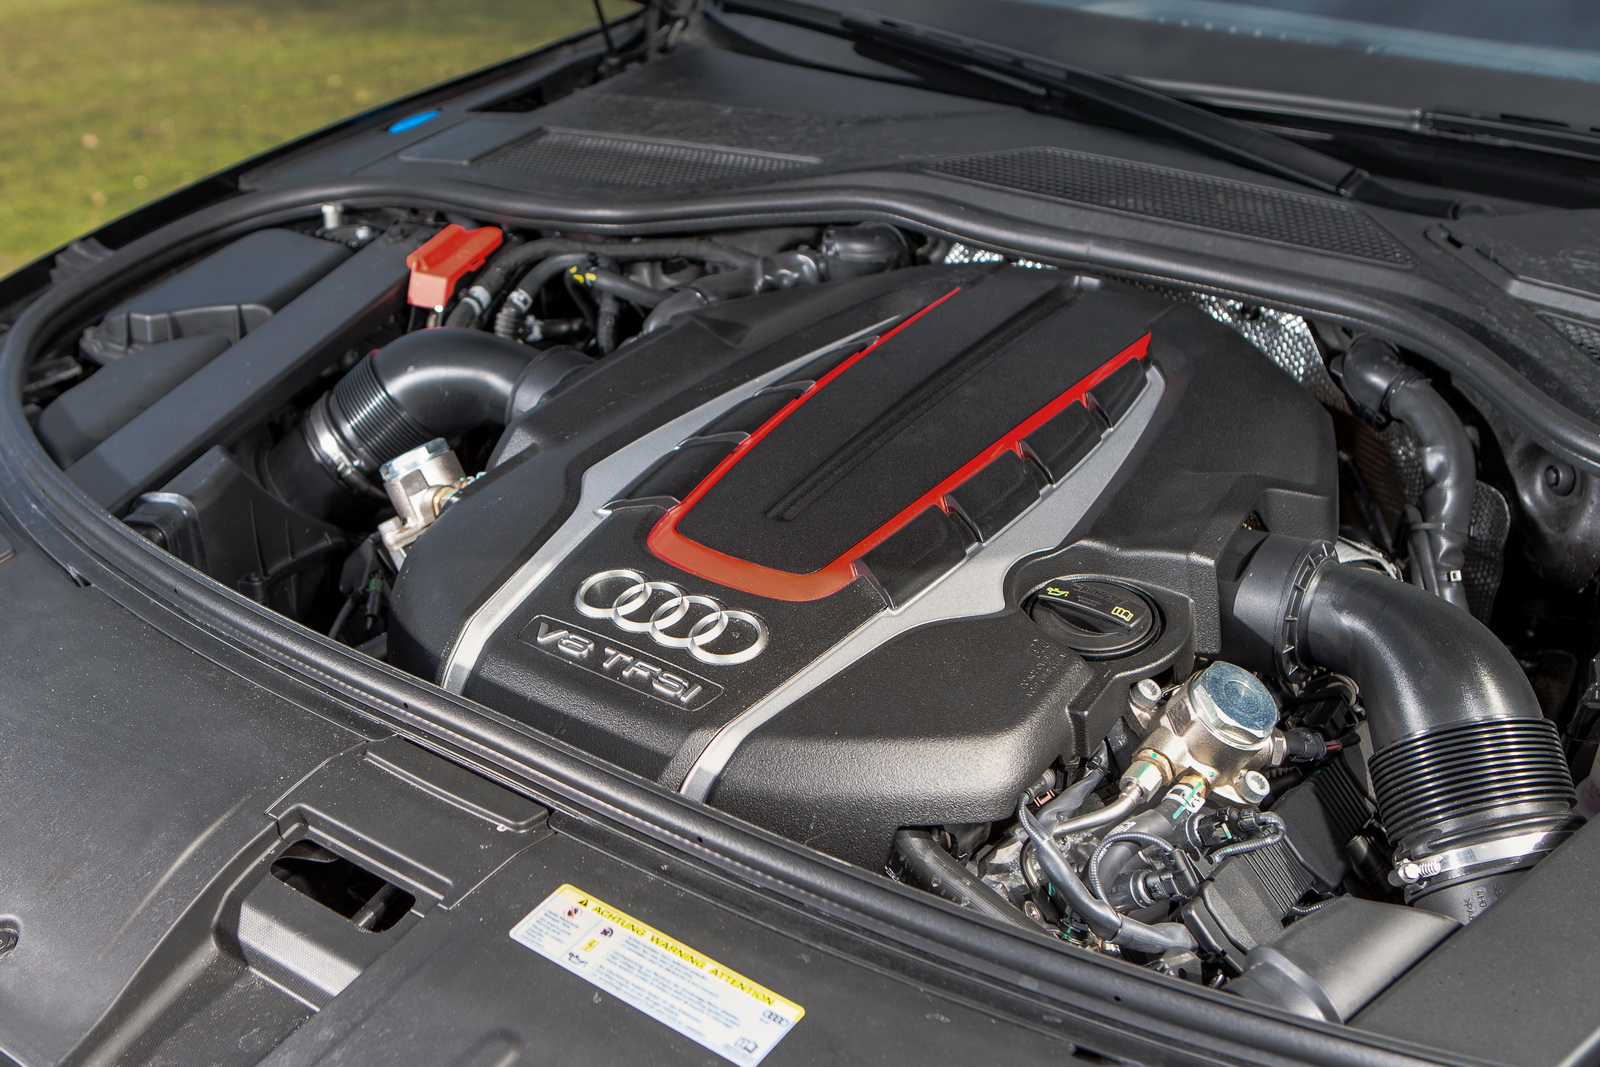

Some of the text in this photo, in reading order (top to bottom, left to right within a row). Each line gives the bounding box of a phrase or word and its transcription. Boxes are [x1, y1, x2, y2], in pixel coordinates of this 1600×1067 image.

[536, 622, 702, 703] V8 TFSI
[592, 906, 646, 937] ACHTUNG
[649, 935, 705, 968] WARNING
[710, 968, 775, 1005] ATTENTION
